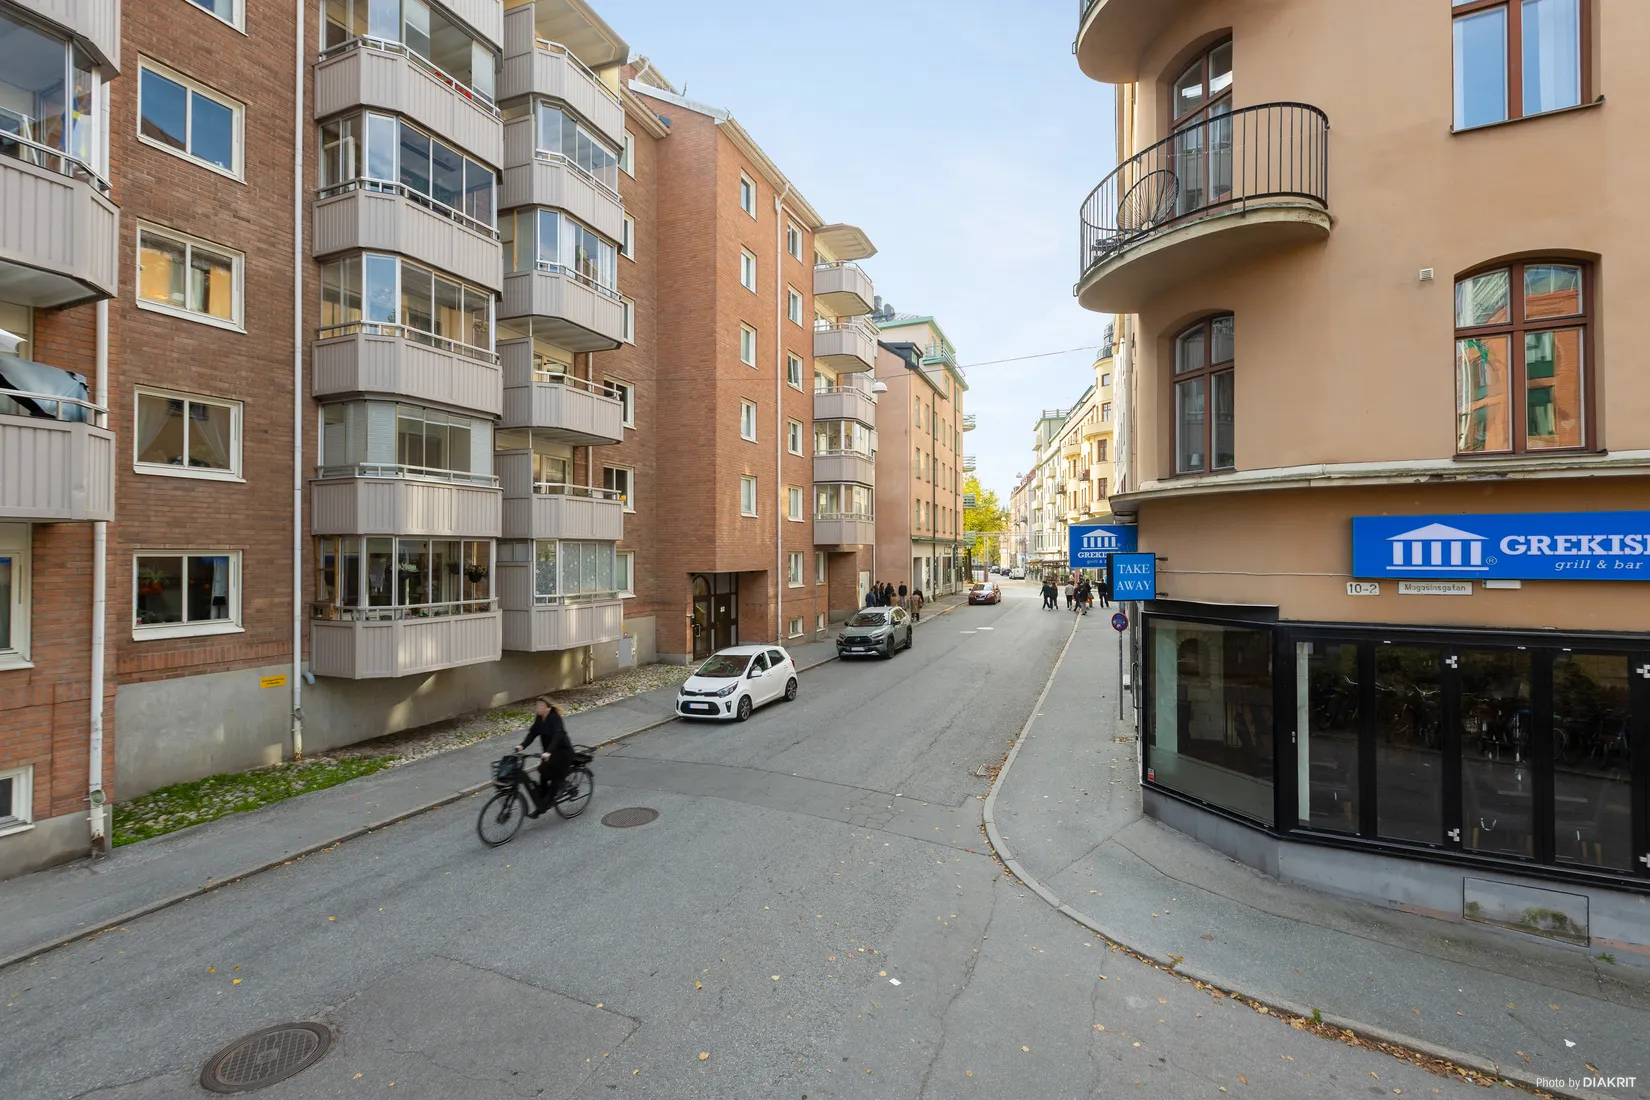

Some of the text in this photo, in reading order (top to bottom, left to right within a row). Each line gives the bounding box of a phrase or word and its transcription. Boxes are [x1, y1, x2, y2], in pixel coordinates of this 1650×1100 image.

[1500, 535, 1650, 555] GREKIS
[1117, 564, 1150, 574] TAKE
[1555, 559, 1643, 571] grill & bar
[1116, 581, 1151, 591] AWAY
[1349, 583, 1377, 594] 10-2
